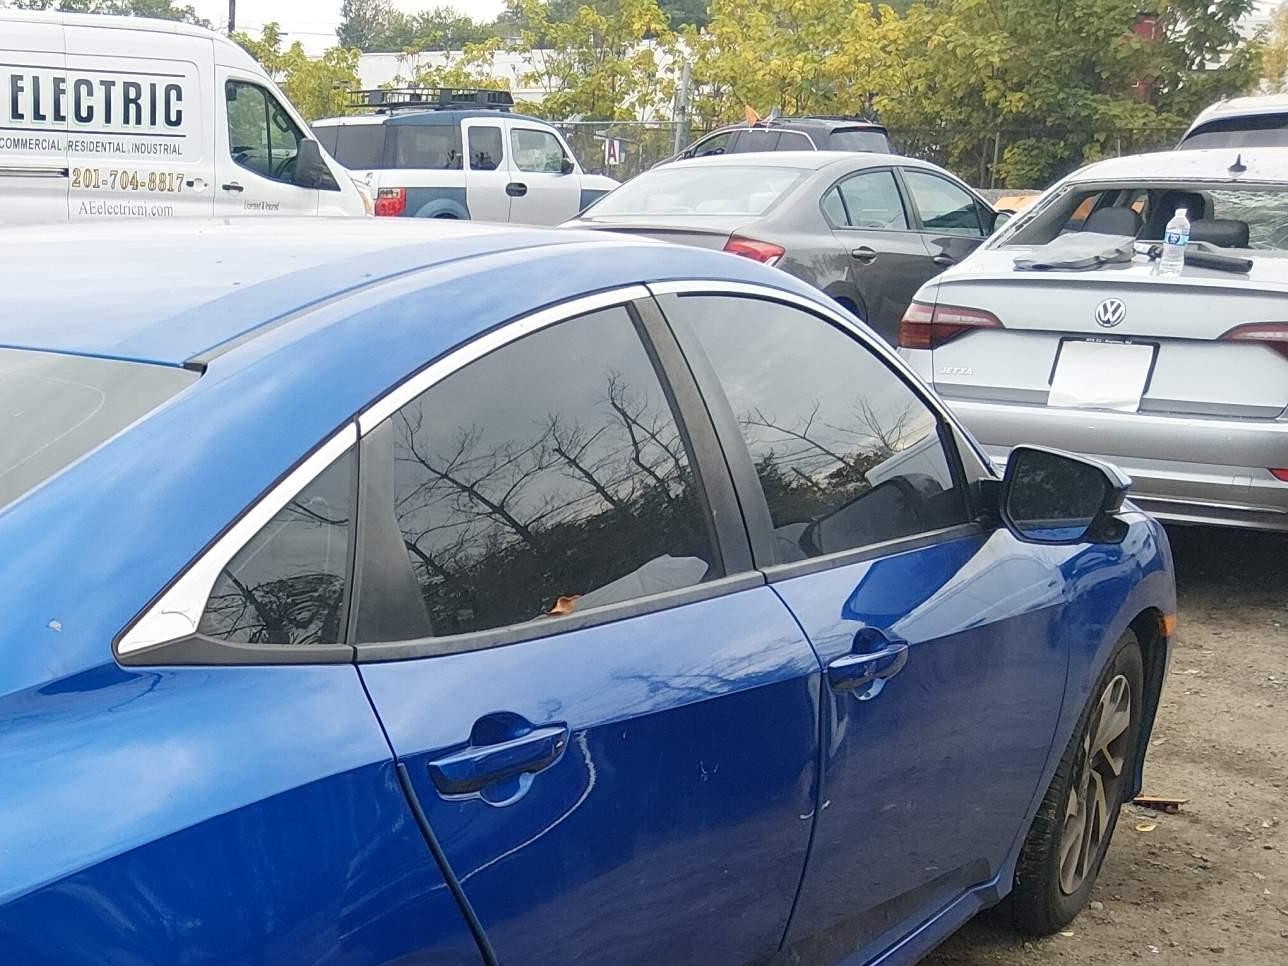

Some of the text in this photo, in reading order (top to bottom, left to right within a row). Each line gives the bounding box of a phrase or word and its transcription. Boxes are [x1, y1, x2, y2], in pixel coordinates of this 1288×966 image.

[9, 74, 183, 128] ELECTRIC
[67, 140, 126, 154] RESIDENTIAL
[130, 143, 183, 156] INDUSTRIAL
[71, 167, 185, 193] 201-704-8817
[940, 366, 976, 377] JETTA
